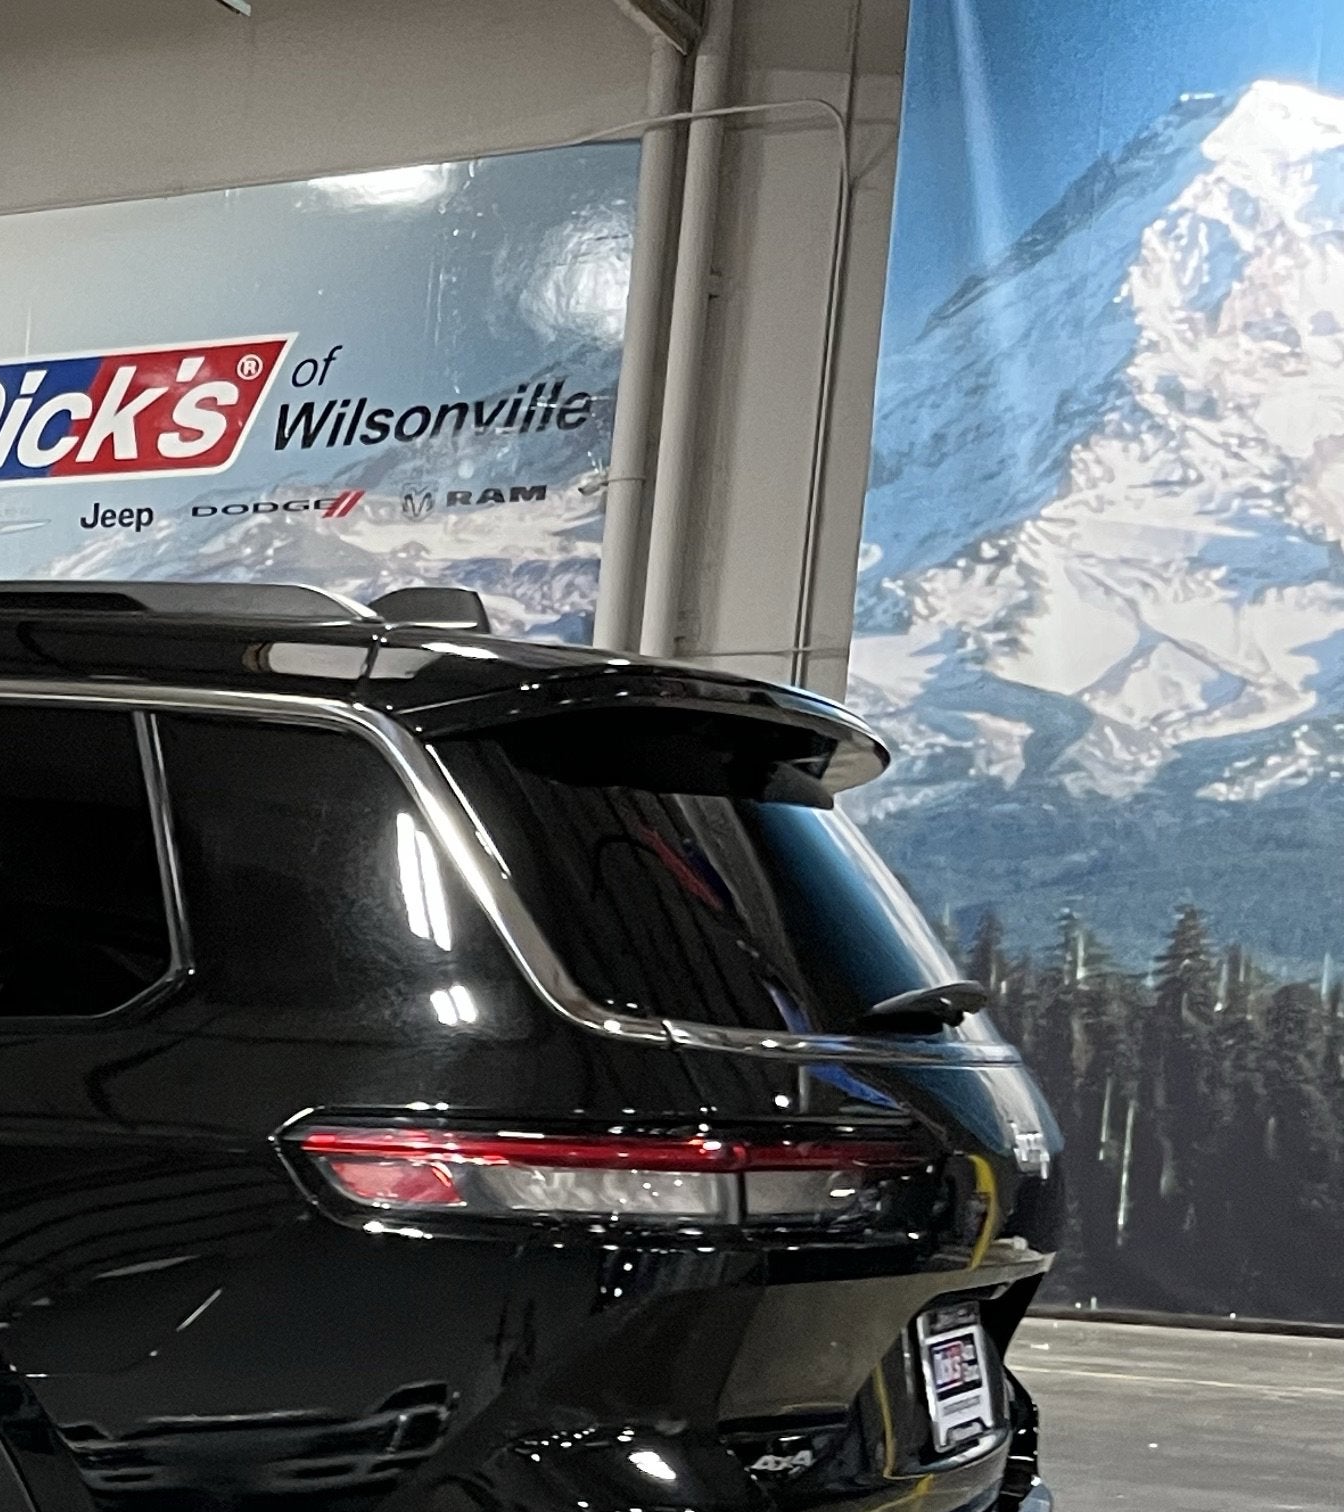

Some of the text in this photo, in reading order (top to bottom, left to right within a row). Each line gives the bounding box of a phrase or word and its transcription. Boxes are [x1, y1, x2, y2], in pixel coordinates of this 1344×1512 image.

[291, 345, 343, 388] of
[274, 376, 593, 451] Wilsonville
[191, 498, 335, 517] DODGE
[446, 485, 547, 507] RAM
[80, 503, 154, 532] Jeep
